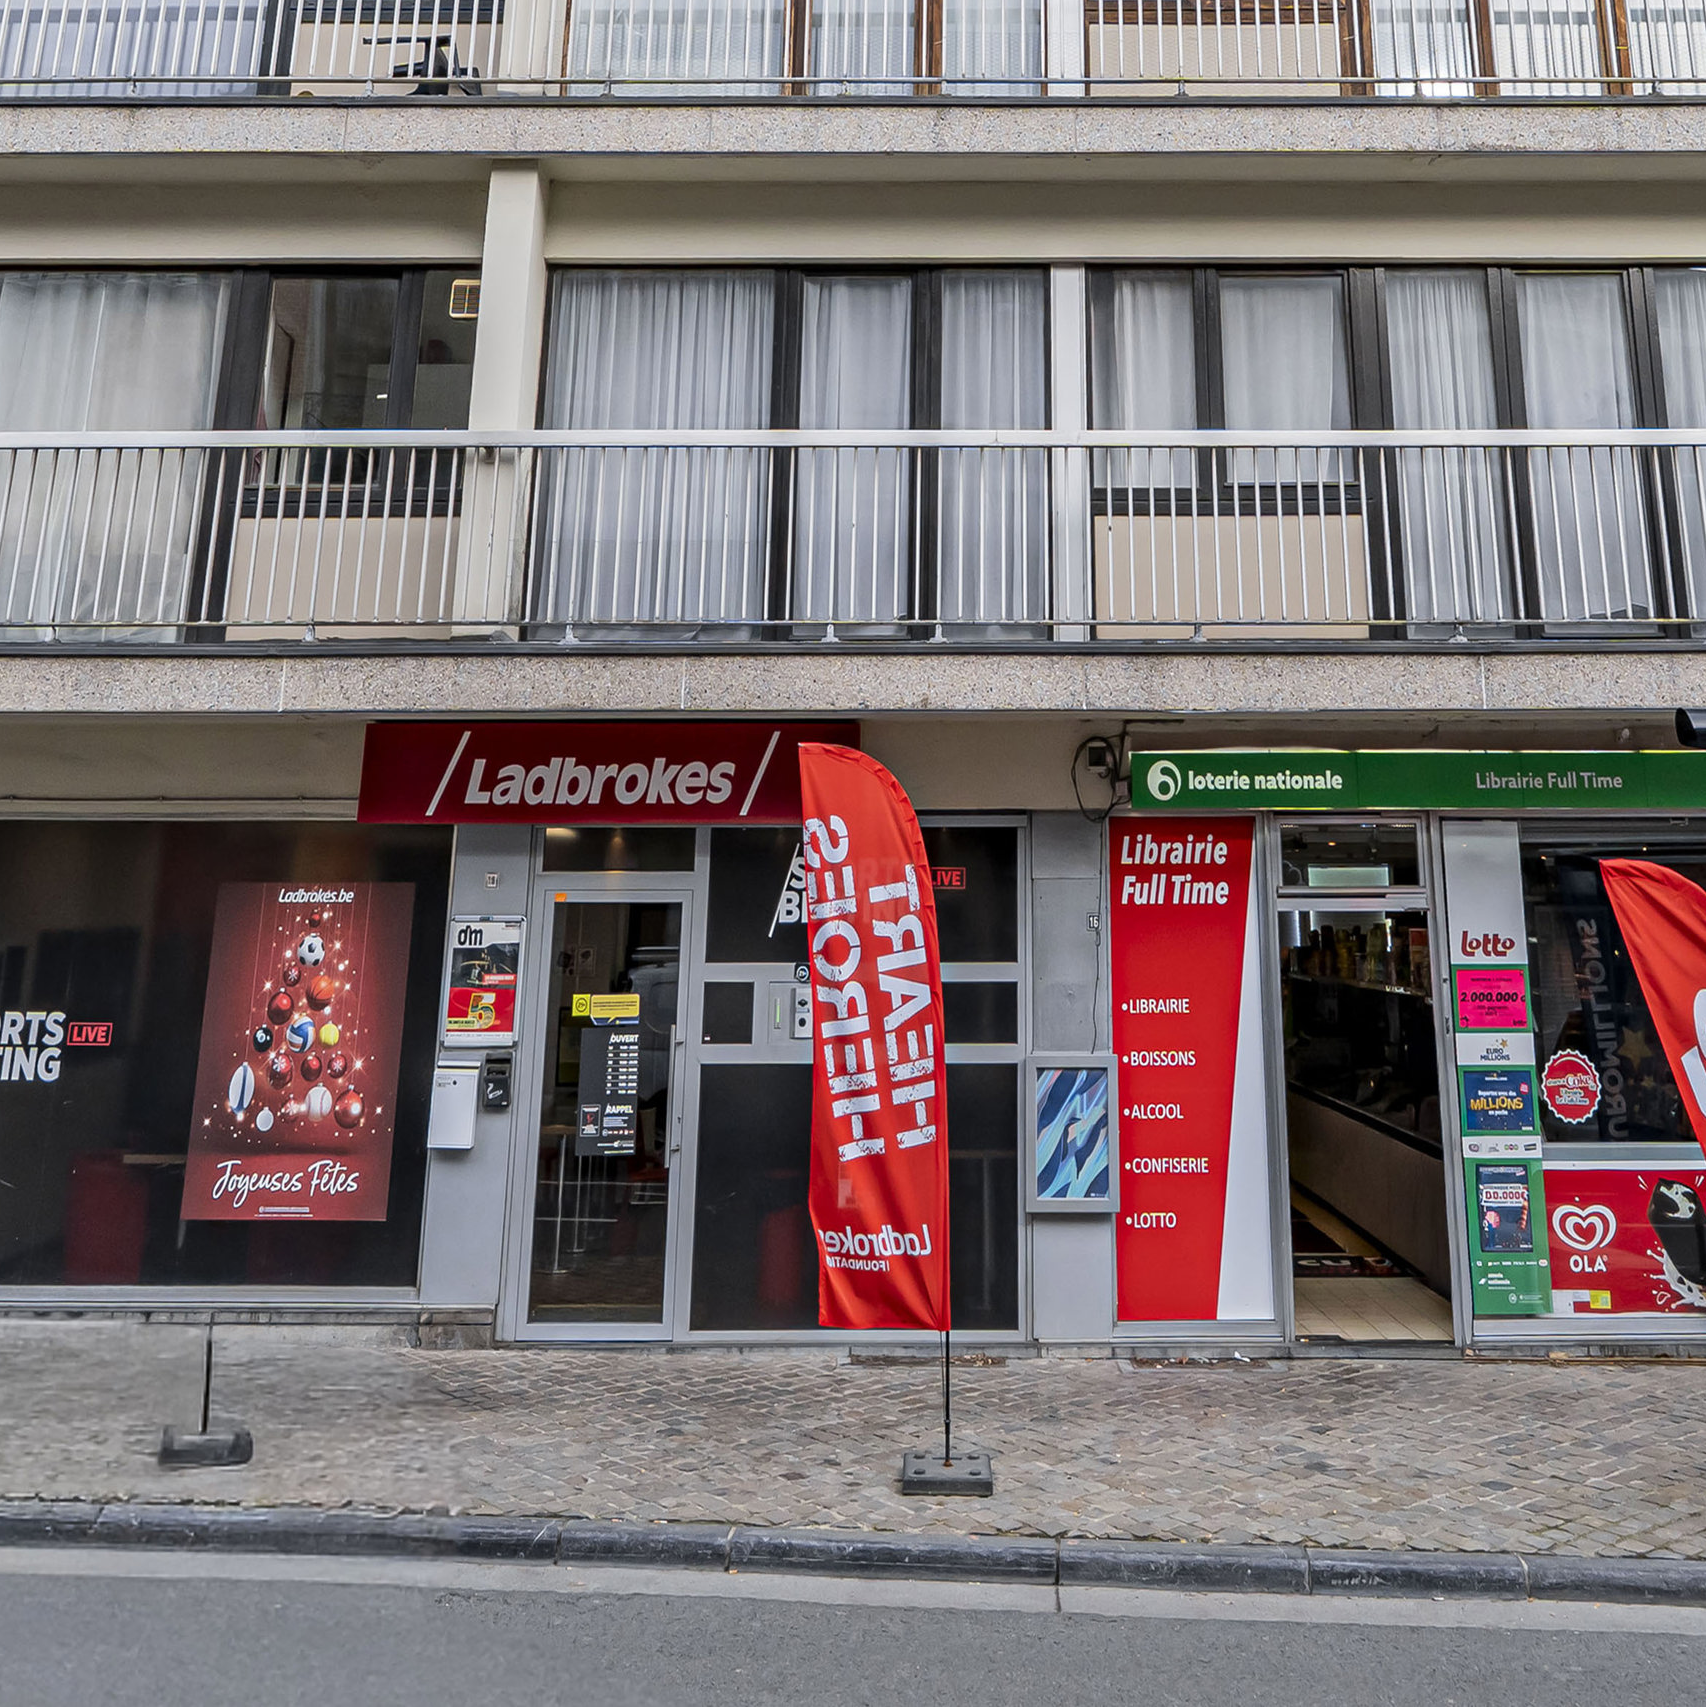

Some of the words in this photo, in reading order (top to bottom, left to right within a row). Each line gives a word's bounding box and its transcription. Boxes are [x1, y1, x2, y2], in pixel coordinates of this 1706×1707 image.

[463, 756, 737, 806] Ladbrokes
[1187, 769, 1250, 790] loterie
[1254, 769, 1343, 790] nationale
[1475, 771, 1543, 789] Librairie
[1547, 771, 1577, 789] Full
[1579, 771, 1623, 789] Time
[1120, 833, 1229, 865] Librairie
[278, 887, 355, 904] Ladbrokes.be
[1121, 873, 1167, 906] Full
[1171, 873, 1230, 905] Time
[1089, 915, 1099, 929] 16
[1460, 991, 1518, 1003] 2.000.000
[1129, 998, 1190, 1014] LIBRAIRIE
[72, 1025, 108, 1042] LIVE
[610, 1033, 639, 1044] OUVERT
[1130, 1050, 1197, 1067] BOISSONS
[1485, 1047, 1504, 1055] EURO
[605, 1104, 634, 1115] RAPPEL
[1131, 1103, 1184, 1120] ALCOOL
[1470, 1096, 1524, 1110] MILLIONS
[1132, 1157, 1210, 1174] CONFISERIE
[212, 1159, 305, 1208] Joyeuses
[307, 1159, 360, 1197] Fêtes
[1133, 1212, 1177, 1229] LOTTO
[1569, 1254, 1608, 1273] OLA
